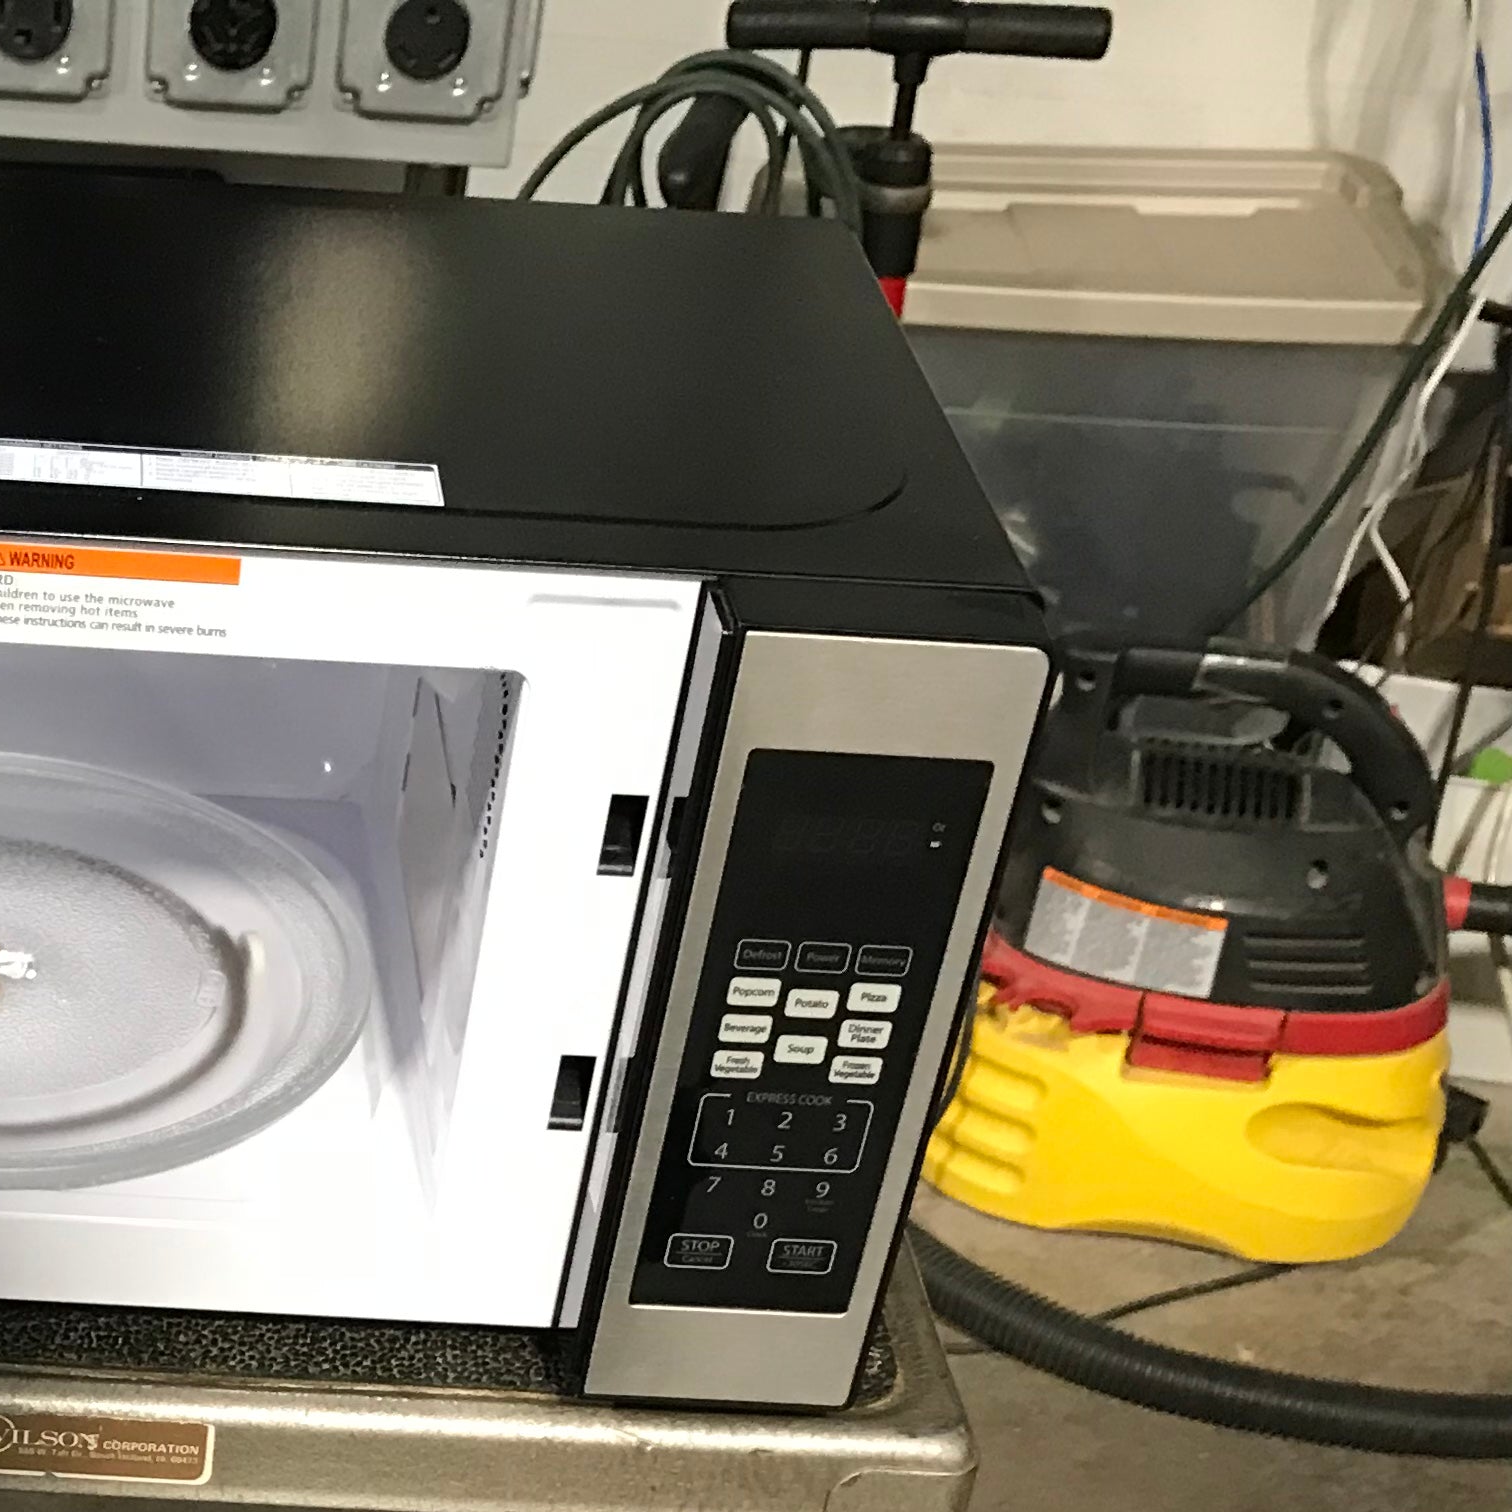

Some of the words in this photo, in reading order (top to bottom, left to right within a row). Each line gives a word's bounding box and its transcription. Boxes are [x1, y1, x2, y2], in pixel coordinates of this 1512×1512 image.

[9, 550, 75, 570] WARNING
[43, 591, 56, 602] to
[60, 593, 81, 603] use
[84, 592, 104, 604] the
[108, 595, 176, 608] microwave
[18, 602, 76, 617] removing
[80, 604, 101, 616] hot
[105, 607, 138, 618] items
[24, 616, 87, 629] instructions
[90, 621, 109, 631] can
[112, 621, 142, 633] result
[145, 623, 155, 633] in
[158, 625, 194, 637] severe
[196, 624, 228, 638] burns
[732, 986, 776, 998] Popcorn
[860, 991, 888, 1003] Pizza
[794, 997, 830, 1009] Potato
[723, 1022, 768, 1035] Beverage
[848, 1023, 884, 1035] Dinner
[850, 1033, 877, 1043] Plate
[787, 1043, 815, 1056] Soup
[746, 1091, 796, 1105] EXPRESS
[798, 1094, 833, 1106] COOK
[726, 1107, 736, 1126] 1
[776, 1111, 793, 1130] 2
[832, 1113, 847, 1132] 3
[713, 1142, 729, 1160] 4
[769, 1145, 786, 1162] 5
[823, 1147, 838, 1165] 6
[706, 1175, 722, 1193] 7
[760, 1178, 776, 1197] 8
[815, 1180, 831, 1198] 9
[752, 1212, 768, 1230] 0
[681, 1238, 721, 1252] STOP
[782, 1244, 825, 1258] START
[102, 1439, 200, 1455] CORPORATION
